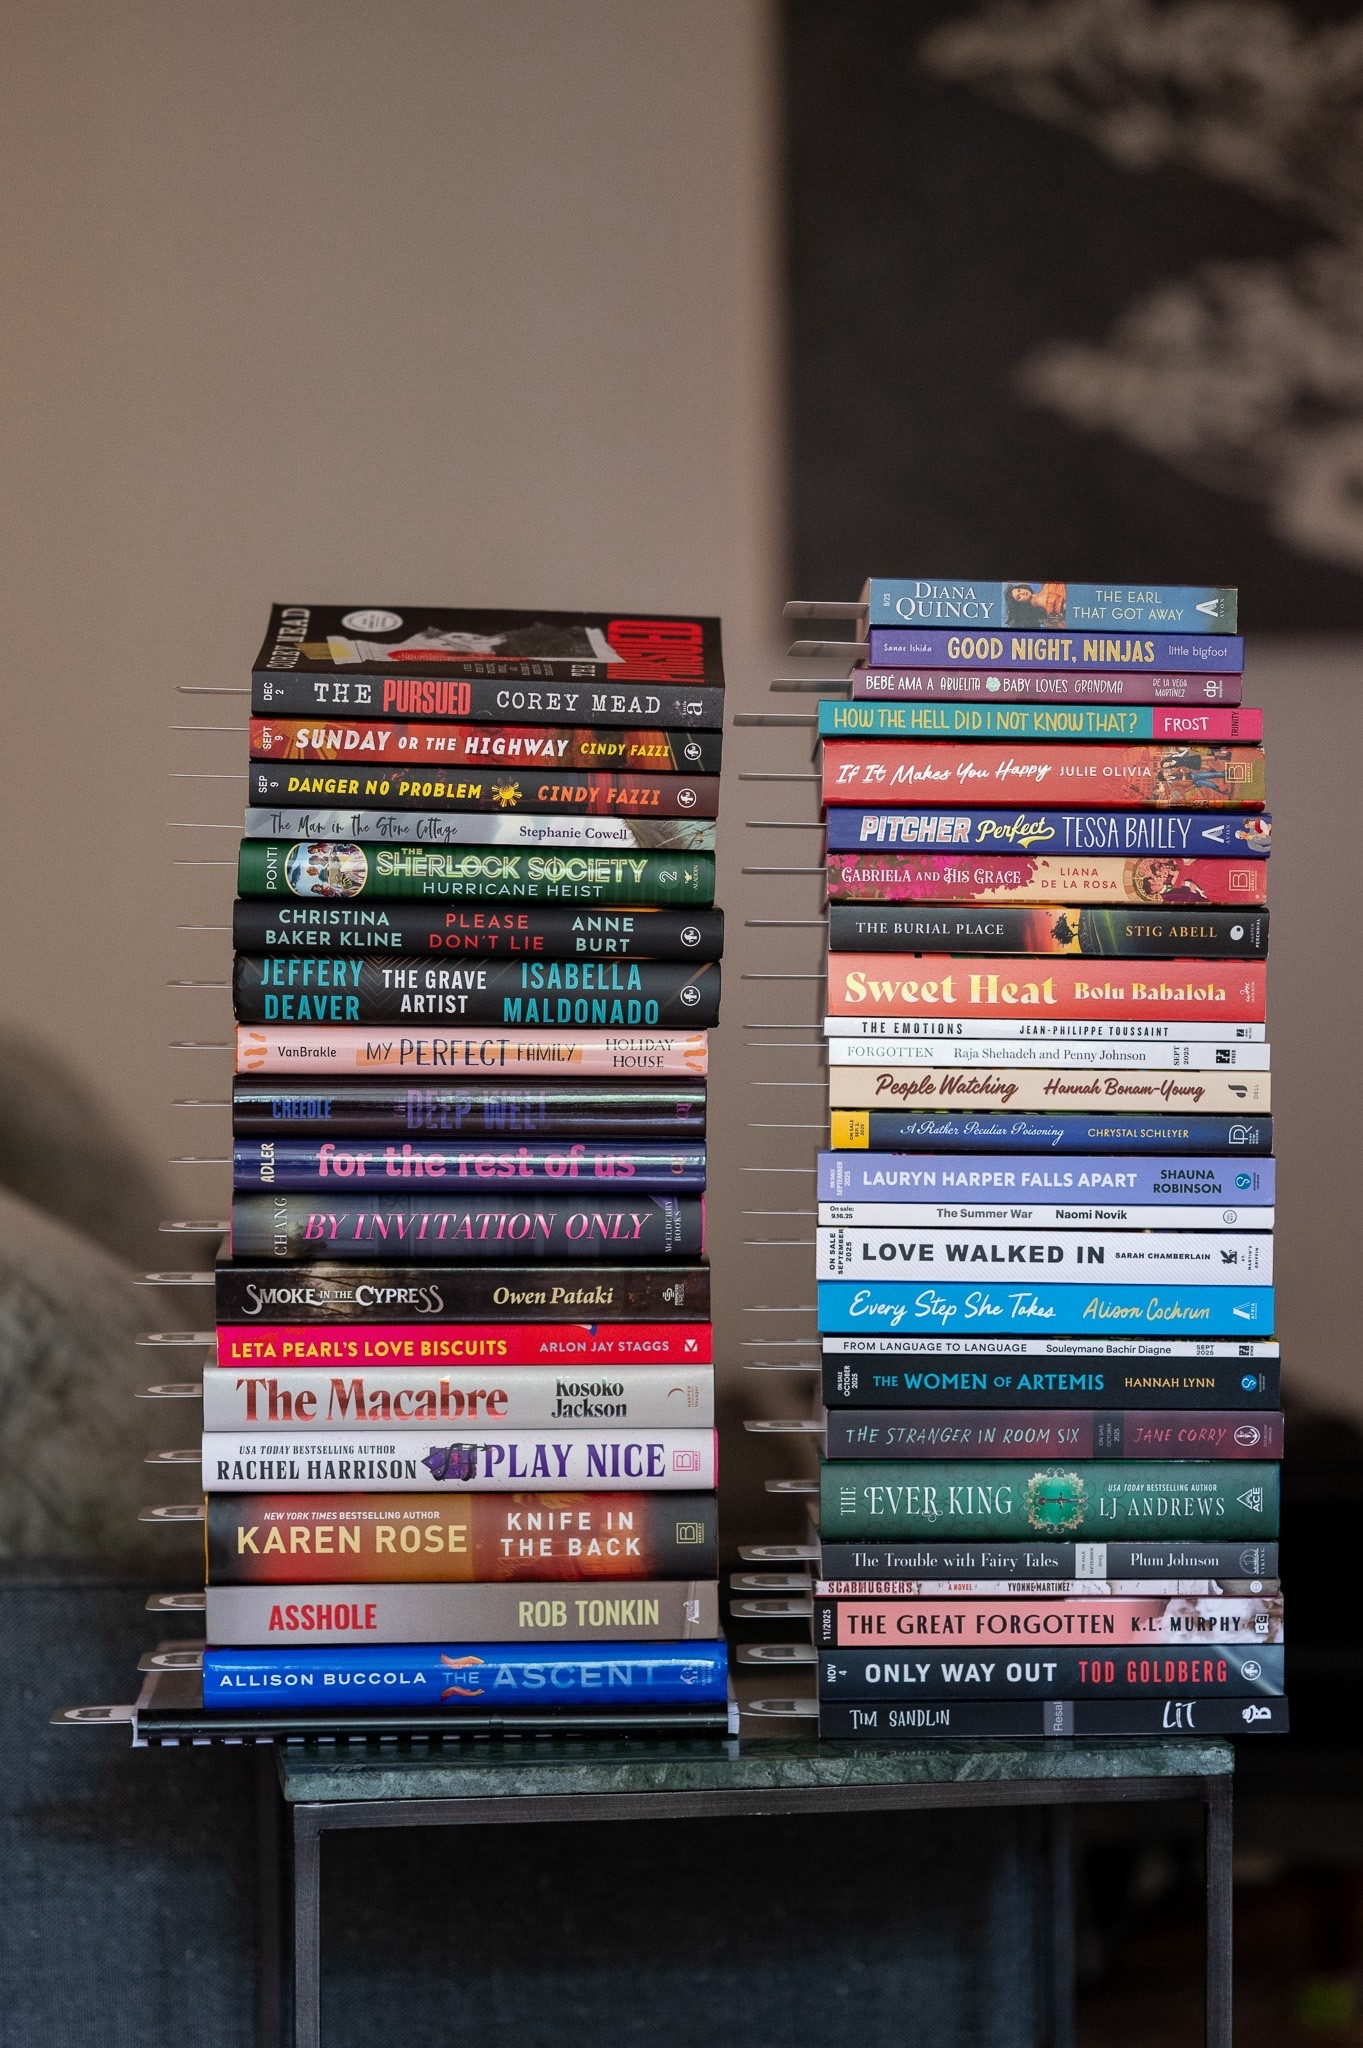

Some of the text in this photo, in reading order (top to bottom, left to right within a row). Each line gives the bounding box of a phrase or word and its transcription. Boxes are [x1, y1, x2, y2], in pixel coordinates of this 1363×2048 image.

[1096, 591, 1162, 604] THE EARL
[1073, 607, 1184, 620] THAT GOT AWAY
[264, 682, 273, 700] DEC
[1003, 679, 1123, 694] BABY LOVES GRANDMA
[314, 680, 471, 715] THE PURSUED
[497, 691, 579, 711] COREY
[592, 695, 661, 714] MEAD
[1165, 717, 1209, 732] FROST
[263, 726, 272, 749] SEPT
[1060, 767, 1151, 777] JULIE OLIVIA
[259, 775, 267, 793] SEP
[288, 778, 482, 799] DANGER NO PROBLEM
[538, 785, 661, 805] CINDY FAZZI
[520, 826, 627, 840] Stephanie Cowell
[1062, 816, 1192, 849] TESSA BAILEY
[267, 847, 278, 890] PONTI
[1060, 868, 1098, 876] LIANA
[424, 882, 603, 897] HURRICANE HEIST
[1042, 880, 1117, 889] DE LA ROSA
[279, 909, 389, 926] CHRISTINA
[446, 914, 528, 929] PLEASE
[856, 922, 1004, 935] THE BURIAL PLACE
[266, 931, 402, 947] BAKER KLINE
[261, 960, 363, 987] JEFFERY
[522, 963, 642, 990] ISABELLA
[845, 971, 1058, 1004] Sweet Heat
[1074, 982, 1226, 1000] Bolu Babalola
[265, 995, 359, 1020] DEAVER
[401, 995, 468, 1013] ARTIST
[504, 998, 659, 1024] MALDONADO
[1020, 1025, 1169, 1036] JEAN-PHILIPPE TOUSSAINT
[278, 1046, 336, 1058] VanBrakle
[848, 1046, 934, 1057] FORGOTTEN
[954, 1048, 1146, 1062] Raja Shehadeh and Penny Johnson
[613, 1056, 664, 1067] HOUSE
[875, 1074, 1018, 1103] People Watching
[272, 1099, 332, 1119] CREEDLE
[1088, 1129, 1189, 1138] CHRYSTAL SCHLEYER
[261, 1143, 274, 1183] ADLER
[316, 1144, 635, 1178] for the rest of us
[1161, 1170, 1214, 1179] SHAUNA
[1153, 1183, 1222, 1194] ROBINSON
[937, 1208, 1033, 1218] The Summer War
[1056, 1209, 1127, 1219] Naomi Novik
[303, 1213, 652, 1240] BY INVITATION ONLY
[830, 1259, 835, 1270] ON
[493, 1286, 613, 1304] Owen Pataki
[540, 1341, 669, 1353] ARLON JAY STAGGS
[844, 1342, 1027, 1352] FROM LANGUAGE TO LANGUAGE
[1046, 1345, 1171, 1355] Souleymane Bachir Diagne
[556, 1376, 624, 1397] Kosoko
[1125, 1378, 1215, 1388] HANNAH LYNN
[236, 1375, 508, 1422] The Macabre
[551, 1399, 627, 1418] Jackson
[846, 1426, 1079, 1445] THE STRANGER IN ROOM SIX
[1134, 1428, 1226, 1445] JANE CORRY
[239, 1446, 395, 1454] USA TODAY BESTSELLING AUTHOR
[286, 1512, 310, 1520] YORK
[311, 1512, 337, 1520] TIMES
[238, 1526, 467, 1554] KAREN ROSE
[501, 1538, 640, 1557] THE BACK
[852, 1553, 1058, 1571] The Trouble with Fairy Tales
[269, 1604, 377, 1630] ASSHOLE
[519, 1601, 567, 1627] ROB
[575, 1599, 659, 1626] TONKIN
[823, 1609, 831, 1640] 11/2025
[848, 1615, 1114, 1634] THE GREAT FORGOTTEN
[220, 1672, 426, 1687] ALLISON BUCCOLA
[828, 1664, 836, 1682] NOV
[865, 1663, 1057, 1683] ONLY WAY OUT
